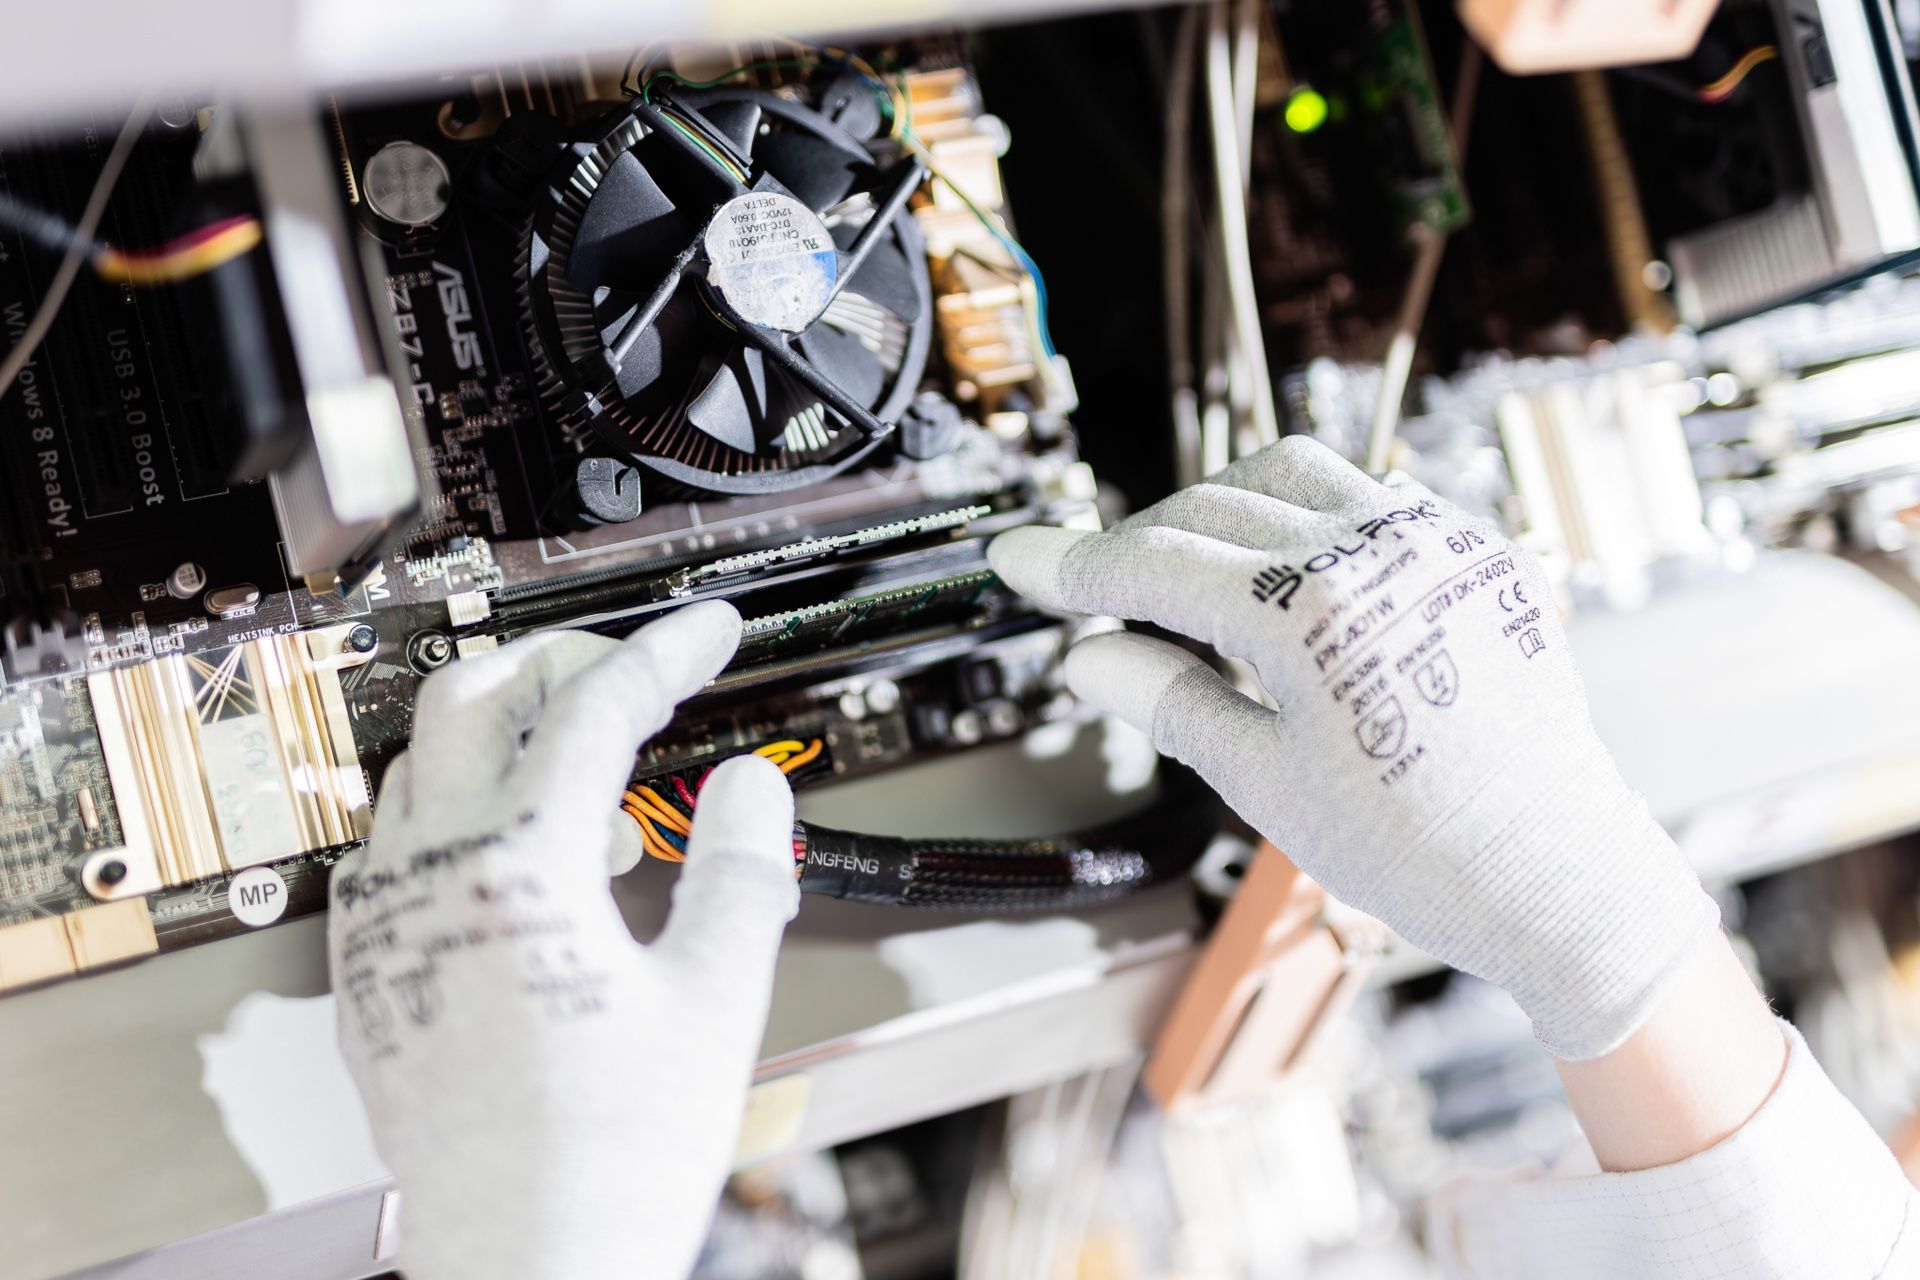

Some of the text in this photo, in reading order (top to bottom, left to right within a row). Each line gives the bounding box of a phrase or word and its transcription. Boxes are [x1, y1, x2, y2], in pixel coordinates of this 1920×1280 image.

[744, 198, 776, 210] DELTA
[762, 207, 792, 219] 12VDC
[432, 260, 484, 370] ASUS
[387, 286, 435, 406] Z87-C
[4, 302, 78, 537] Wiows 8 Ready!
[107, 329, 165, 506] USB 3.0 Boost
[228, 623, 299, 644] HEATSINK PCH
[807, 850, 880, 875] NGFENG
[240, 883, 278, 907] MP
